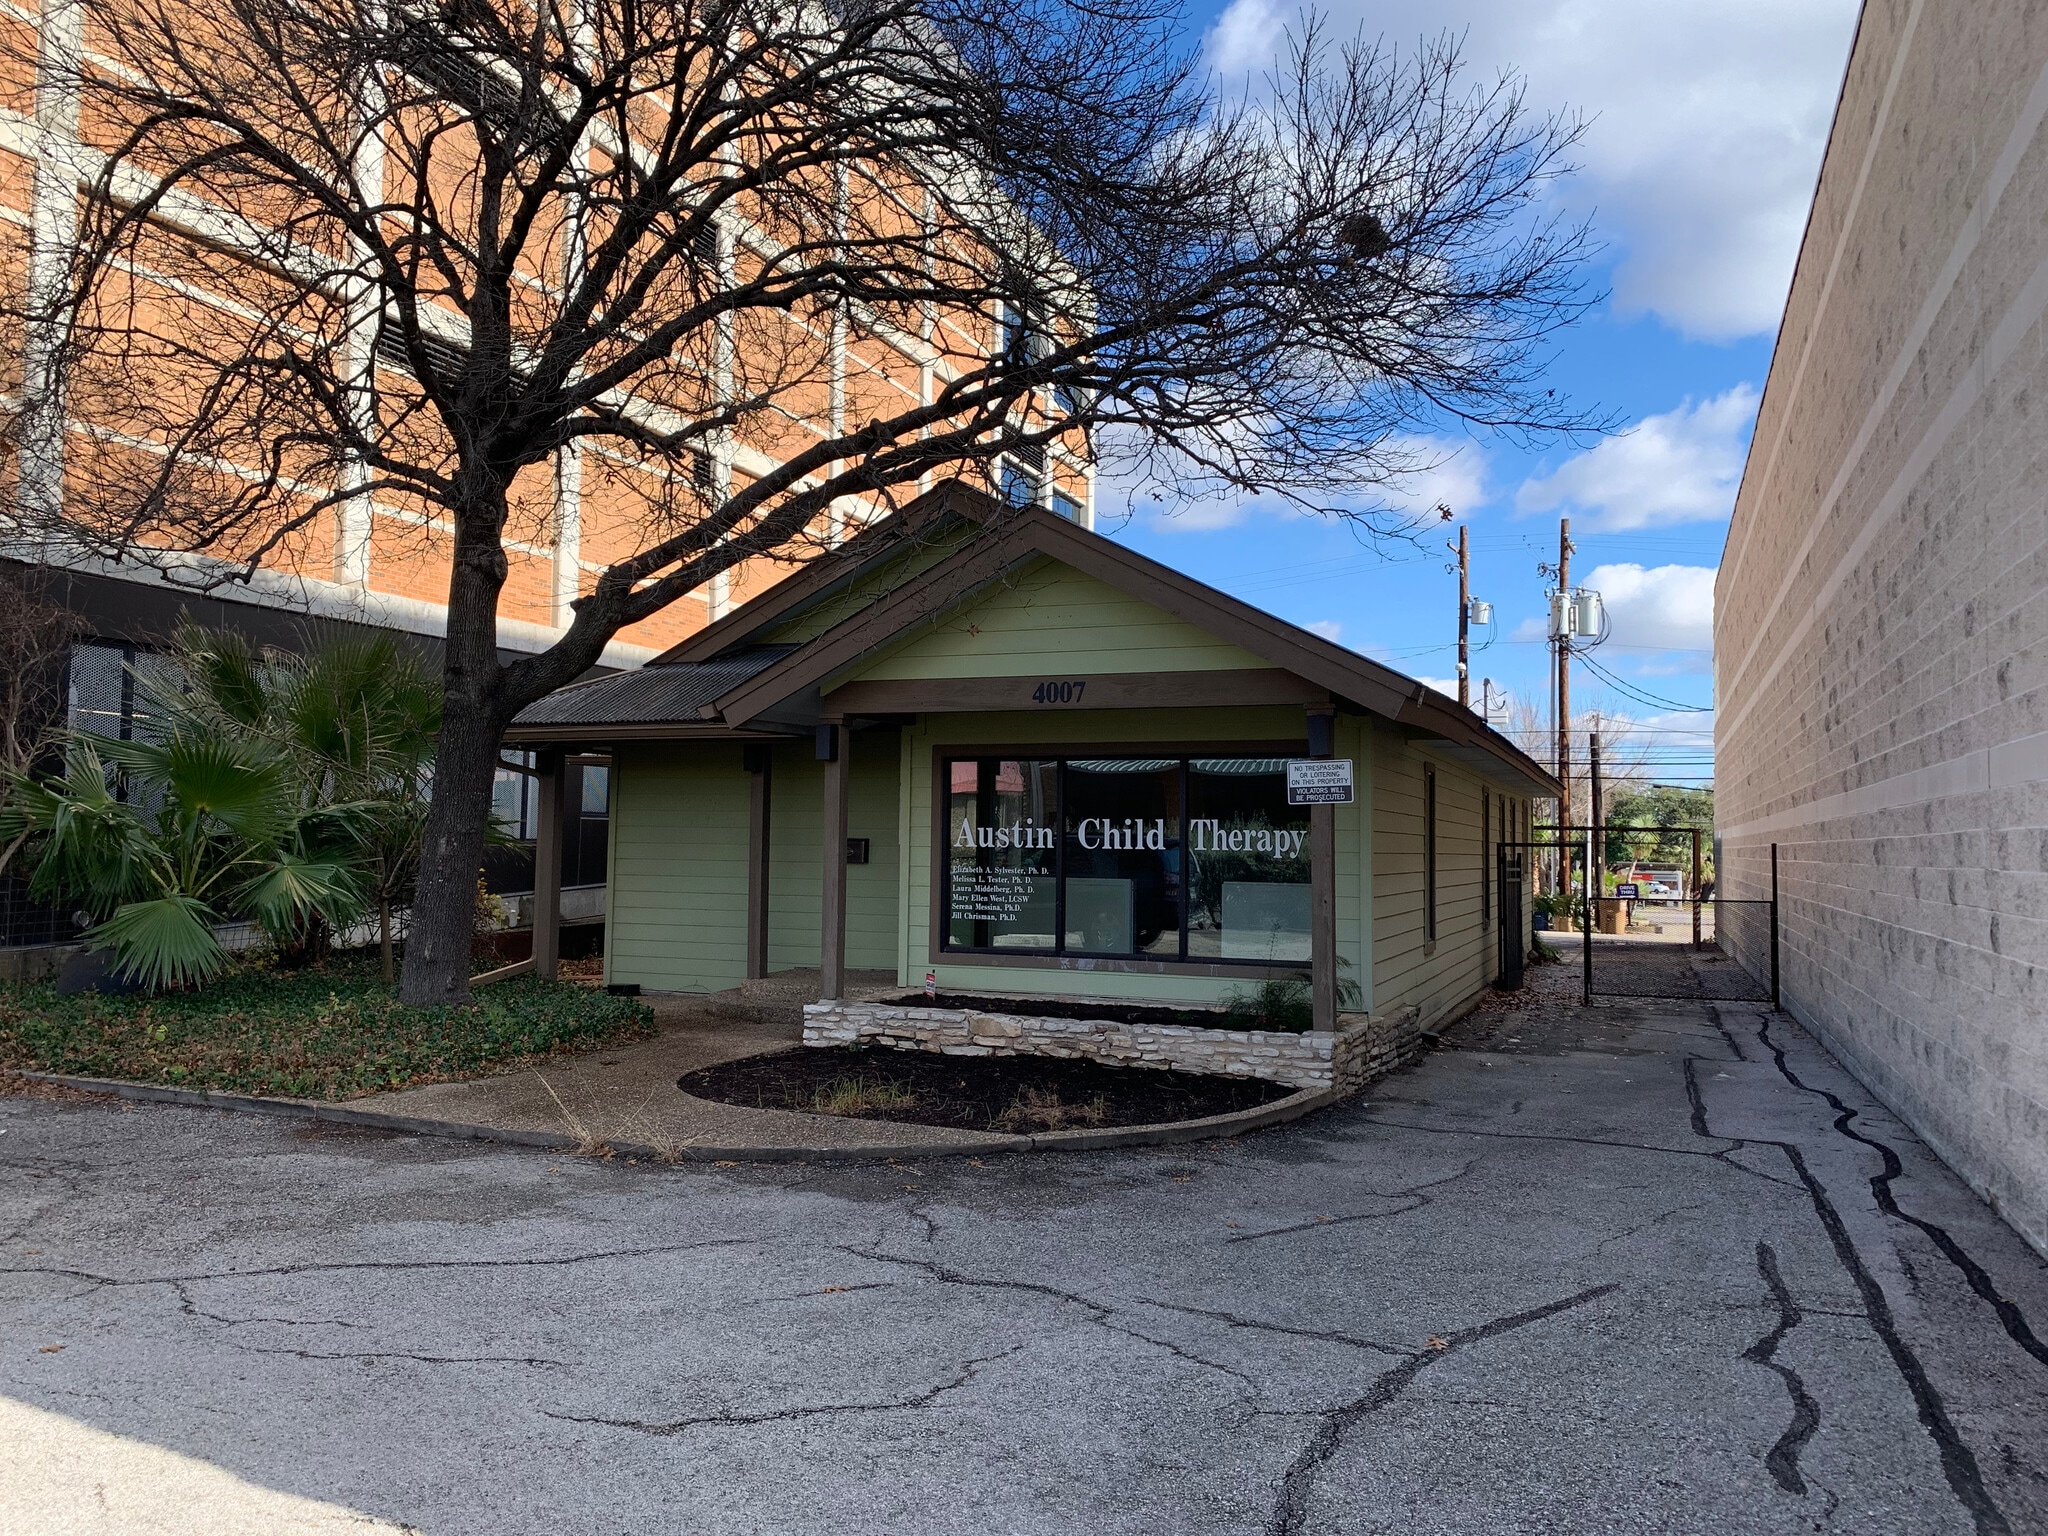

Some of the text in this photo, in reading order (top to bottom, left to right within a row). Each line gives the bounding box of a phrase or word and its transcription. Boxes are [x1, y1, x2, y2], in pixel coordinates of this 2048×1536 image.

[1032, 681, 1086, 703] 4007
[954, 817, 1307, 859] Austin Child Therapy
[952, 866, 983, 874] Elizabeth
[994, 866, 1026, 875] Sylvester,
[987, 876, 1010, 884] Tester,
[974, 885, 1012, 894] Middelberg,
[975, 903, 1002, 912] Messina,
[964, 913, 997, 921] Chrisman,
